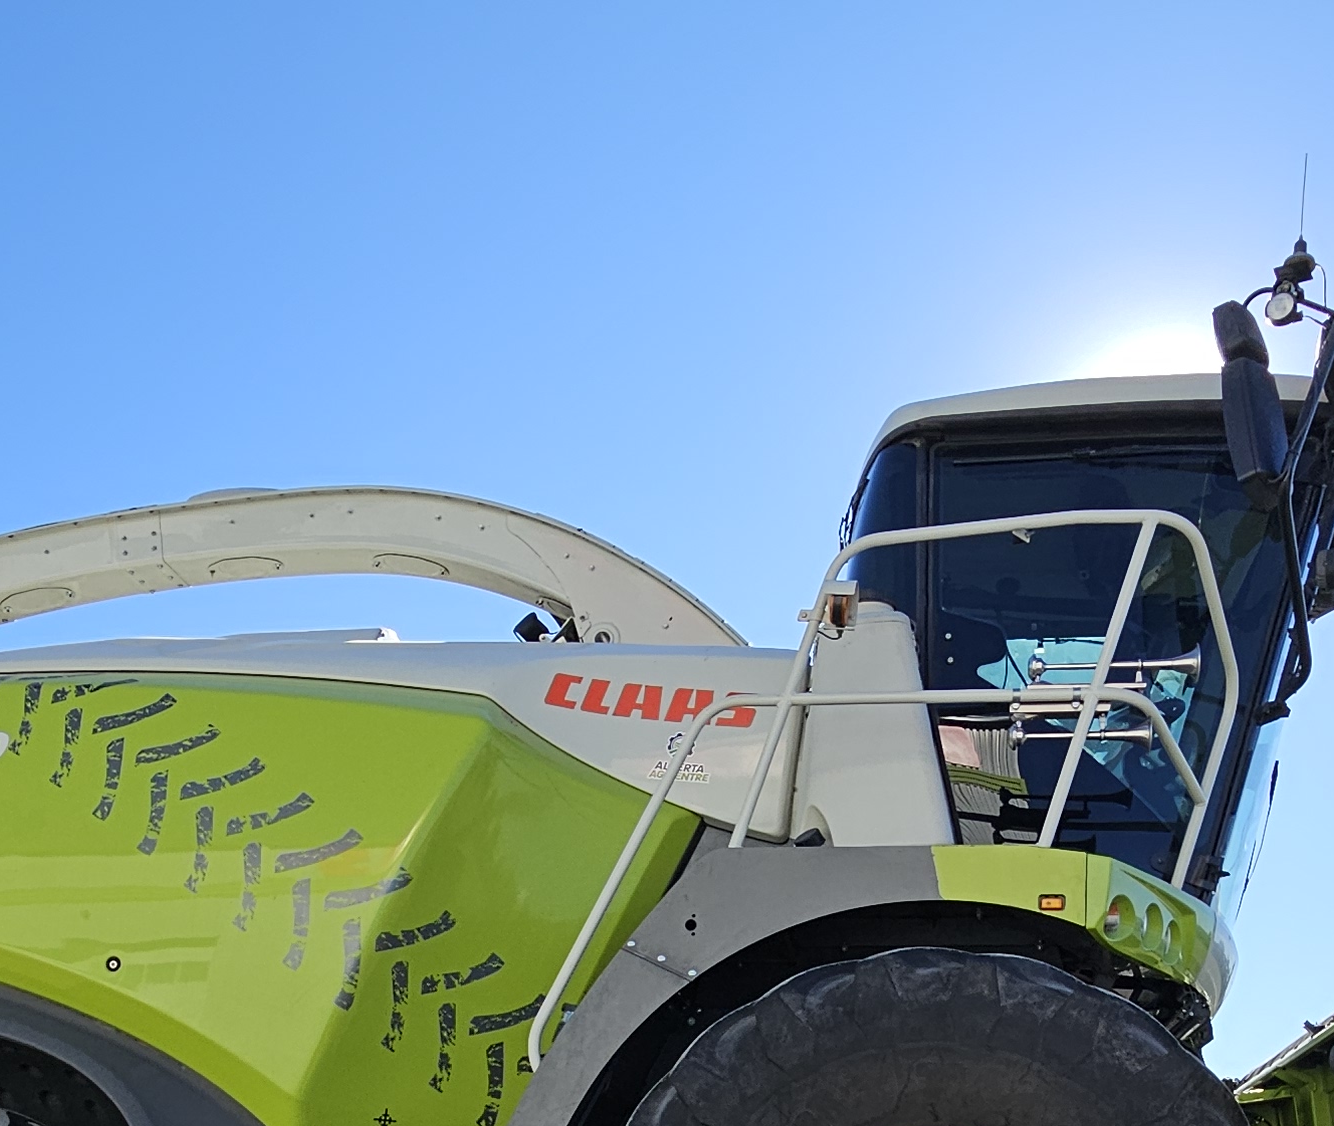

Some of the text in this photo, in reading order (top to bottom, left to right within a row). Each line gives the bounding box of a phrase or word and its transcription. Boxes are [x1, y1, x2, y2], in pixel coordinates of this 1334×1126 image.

[544, 672, 758, 728] CLAAS
[655, 761, 704, 773] ALERTA
[673, 772, 710, 782] ENTRE
